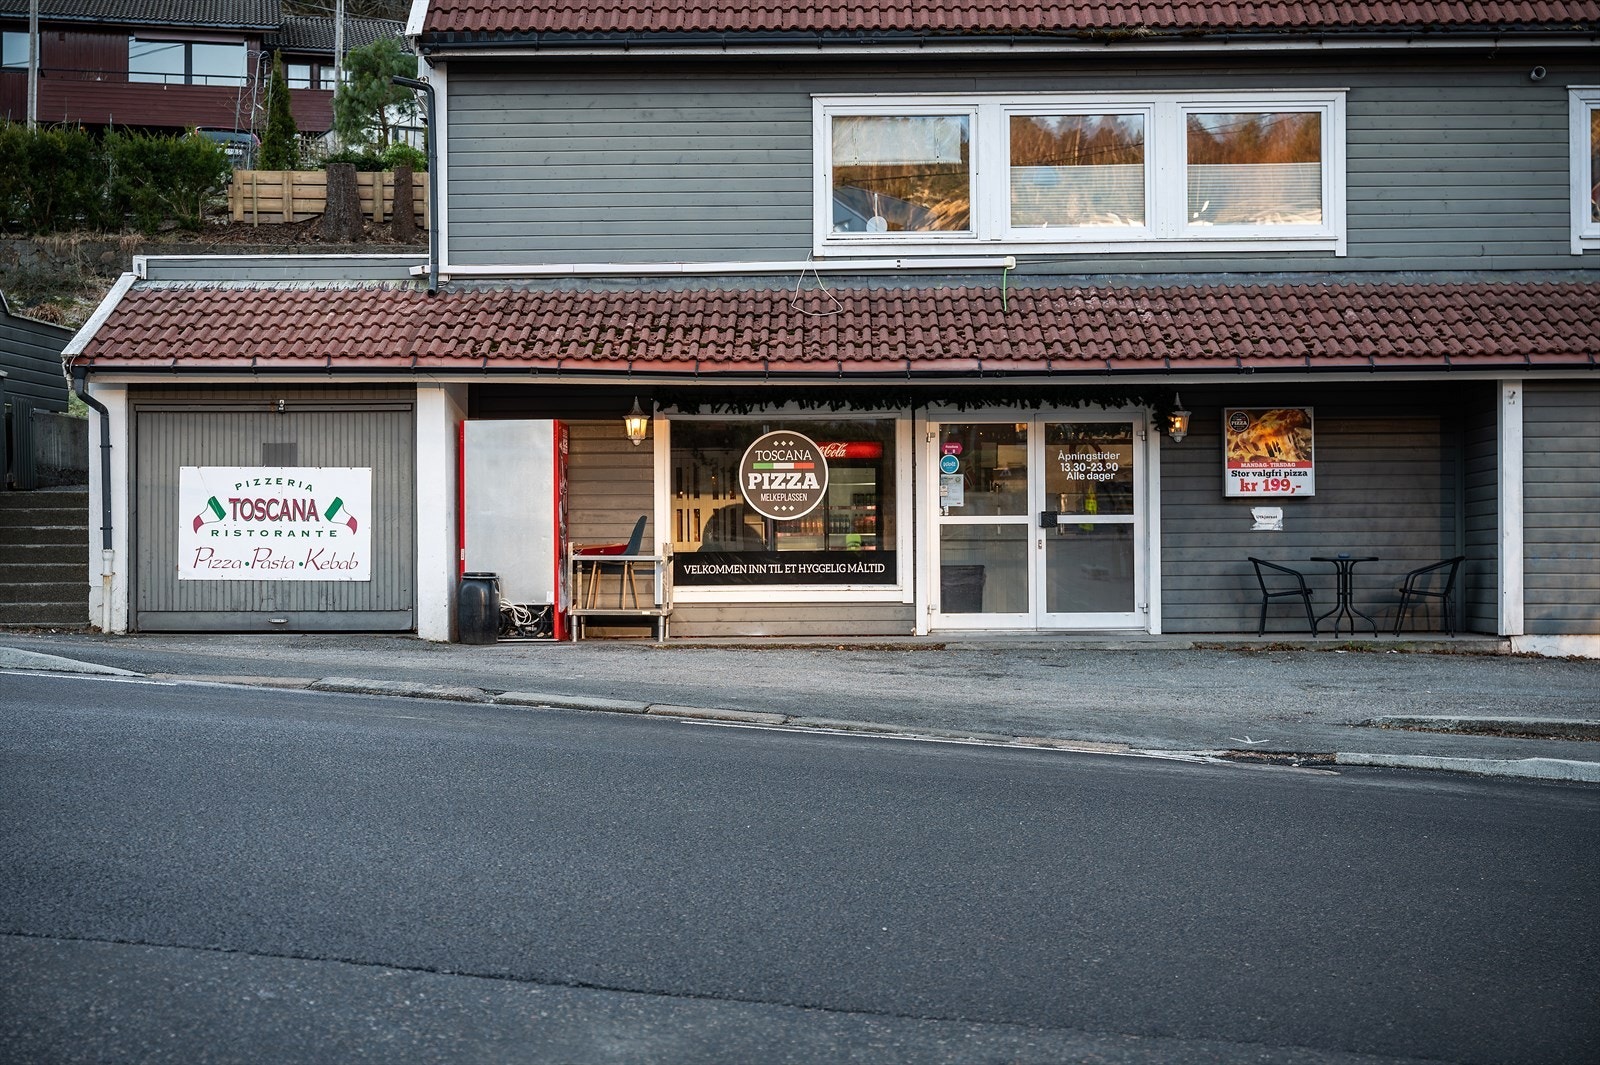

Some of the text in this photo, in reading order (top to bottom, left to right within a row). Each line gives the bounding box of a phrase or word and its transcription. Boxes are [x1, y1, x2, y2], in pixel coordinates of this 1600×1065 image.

[755, 449, 812, 461] TOSCANA
[1058, 449, 1121, 462] Åpningstider
[1060, 462, 1119, 472] 13.30-23.00
[1231, 469, 1308, 478] Stor valgfri pizza
[748, 472, 820, 490] PIZZA
[1066, 471, 1116, 482] Alle dager
[234, 477, 313, 492] PIZZERIA
[1240, 478, 1302, 494] kr 199,-
[760, 493, 808, 502] MELKEPLASSEN
[228, 497, 320, 522] TOSCANA
[211, 529, 338, 538] RISTORANTE
[192, 546, 359, 571] Pizza Pasta Kebab
[683, 561, 886, 575] VELKOMMEN INN TIL ET HYGGELIG MÅLTID
